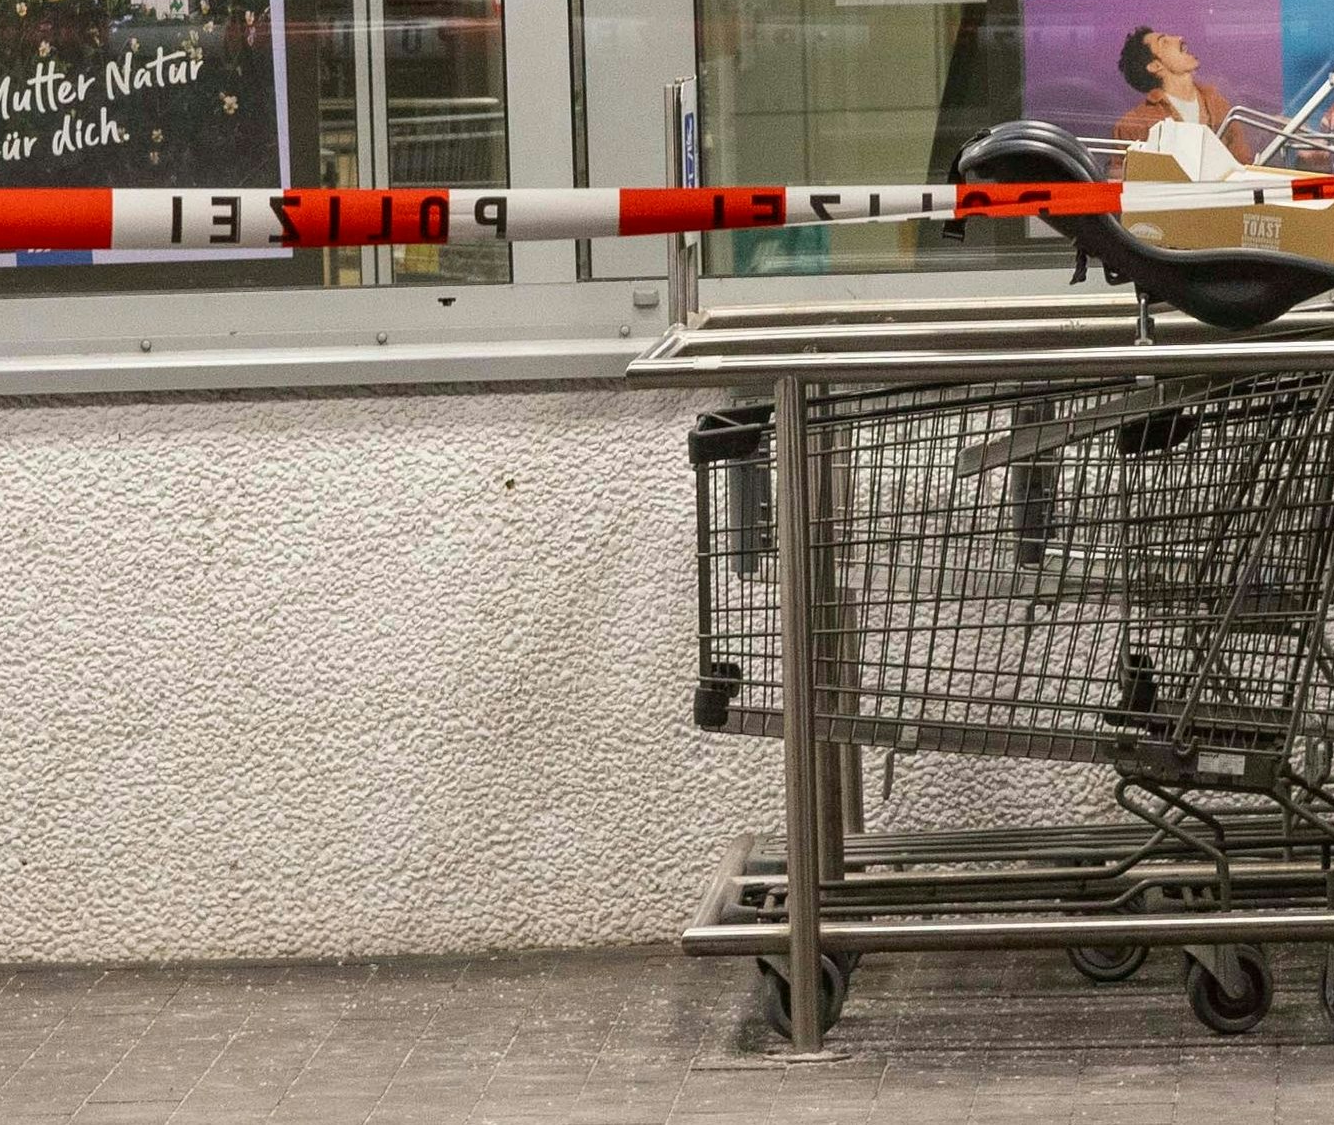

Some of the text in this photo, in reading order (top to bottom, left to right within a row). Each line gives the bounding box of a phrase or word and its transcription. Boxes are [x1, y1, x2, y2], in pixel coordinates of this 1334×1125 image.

[104, 46, 205, 100] Natur
[51, 106, 130, 157] dich.
[1242, 220, 1282, 239] TOAST
